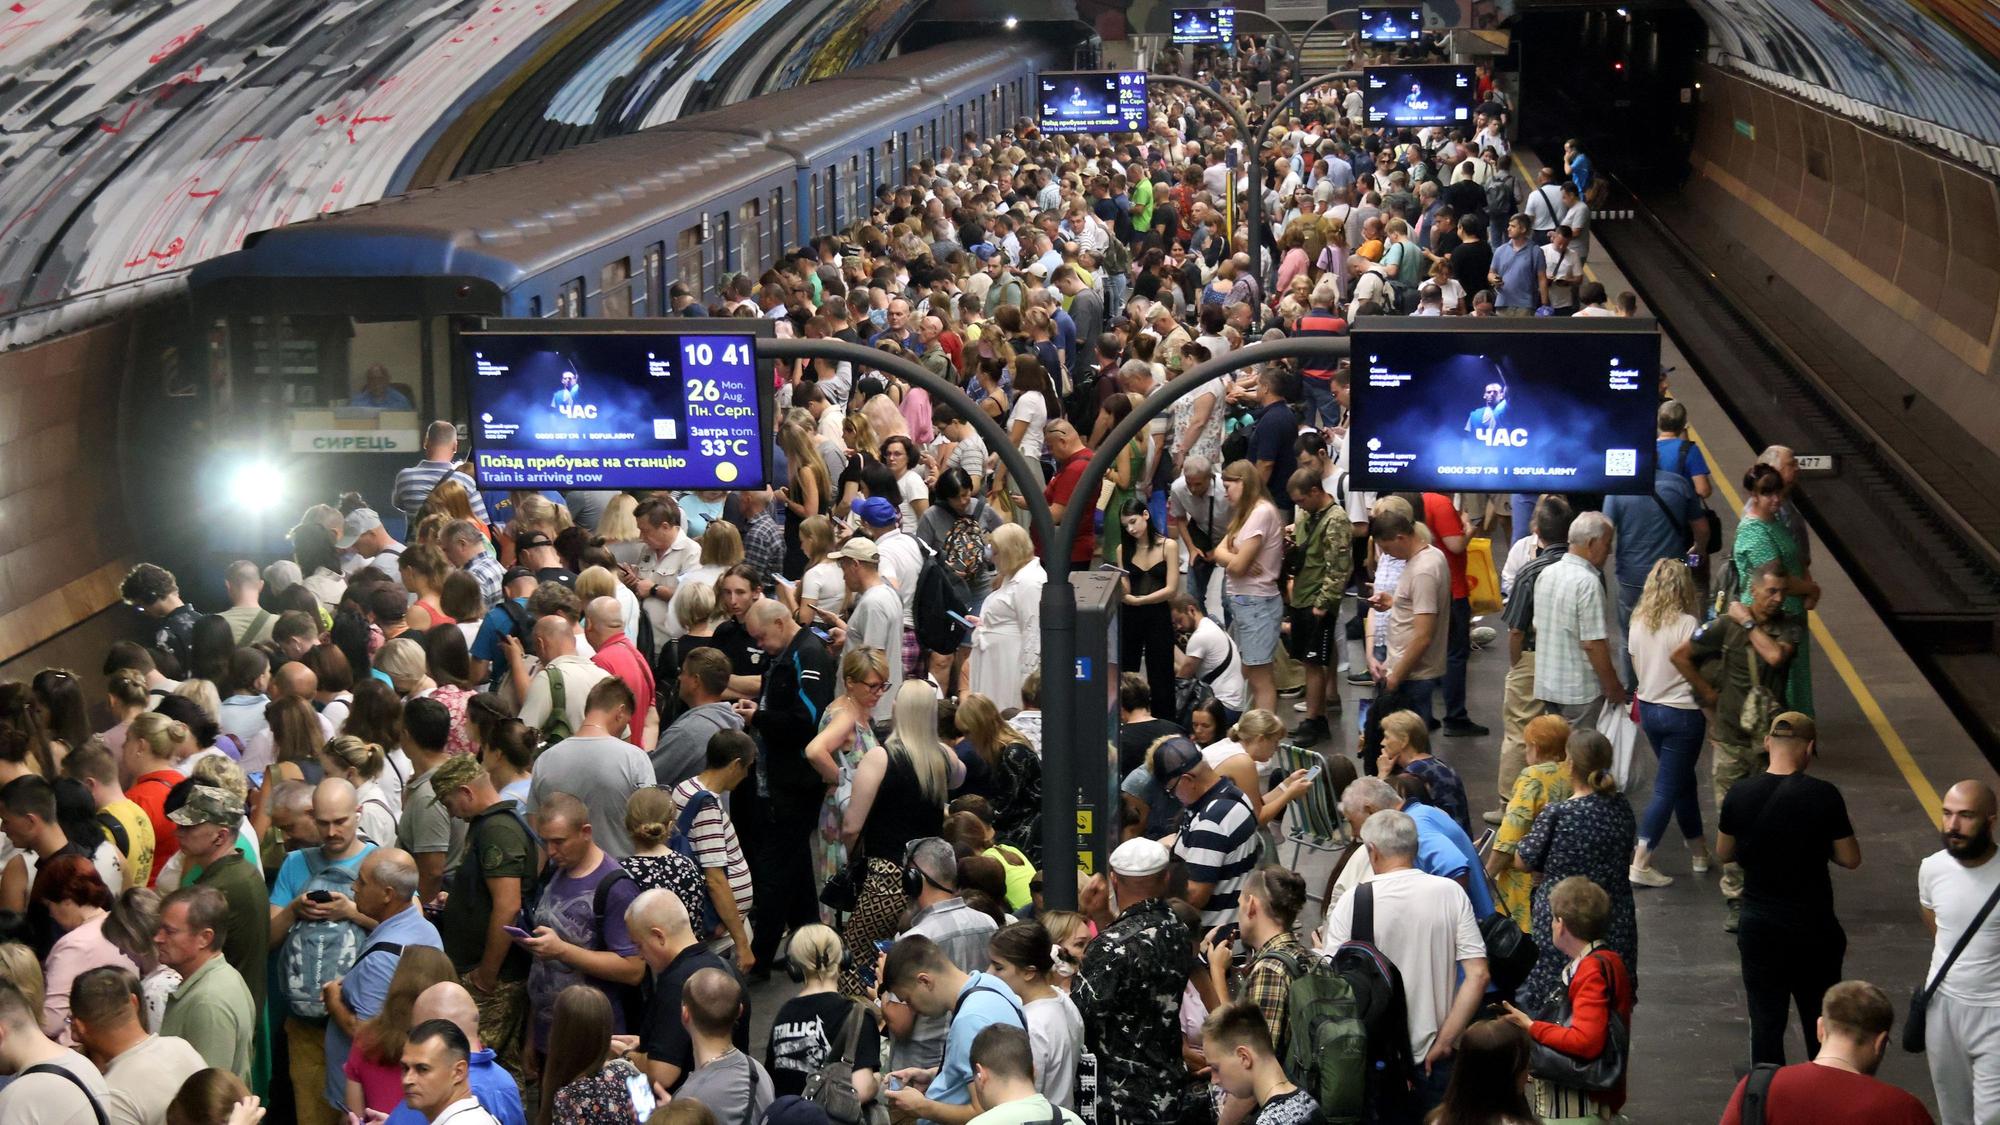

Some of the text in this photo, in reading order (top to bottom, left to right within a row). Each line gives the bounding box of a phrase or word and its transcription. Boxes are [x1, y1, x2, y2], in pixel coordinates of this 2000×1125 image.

[1120, 75, 1145, 85] 10 41
[1120, 89, 1133, 99] 26
[685, 344, 750, 366] 10 41
[687, 379, 720, 402] 26
[721, 381, 746, 390] Mon.
[723, 392, 745, 403] Aug.
[559, 404, 598, 419] ЧАС
[688, 404, 755, 419] Пн. Серп.
[690, 427, 729, 438] Завтра
[1475, 428, 1528, 447] ЧАС
[313, 436, 397, 450] СИРЕЦЬ
[700, 439, 749, 456] 33°C
[480, 454, 686, 472] Поїзд прибуває на станцію
[1437, 466, 1464, 474] 0800
[1465, 466, 1482, 474] 357
[1484, 466, 1498, 475] 174
[1513, 467, 1577, 475] SOFUA.ARMY
[482, 471, 603, 485] Train is arriving now
